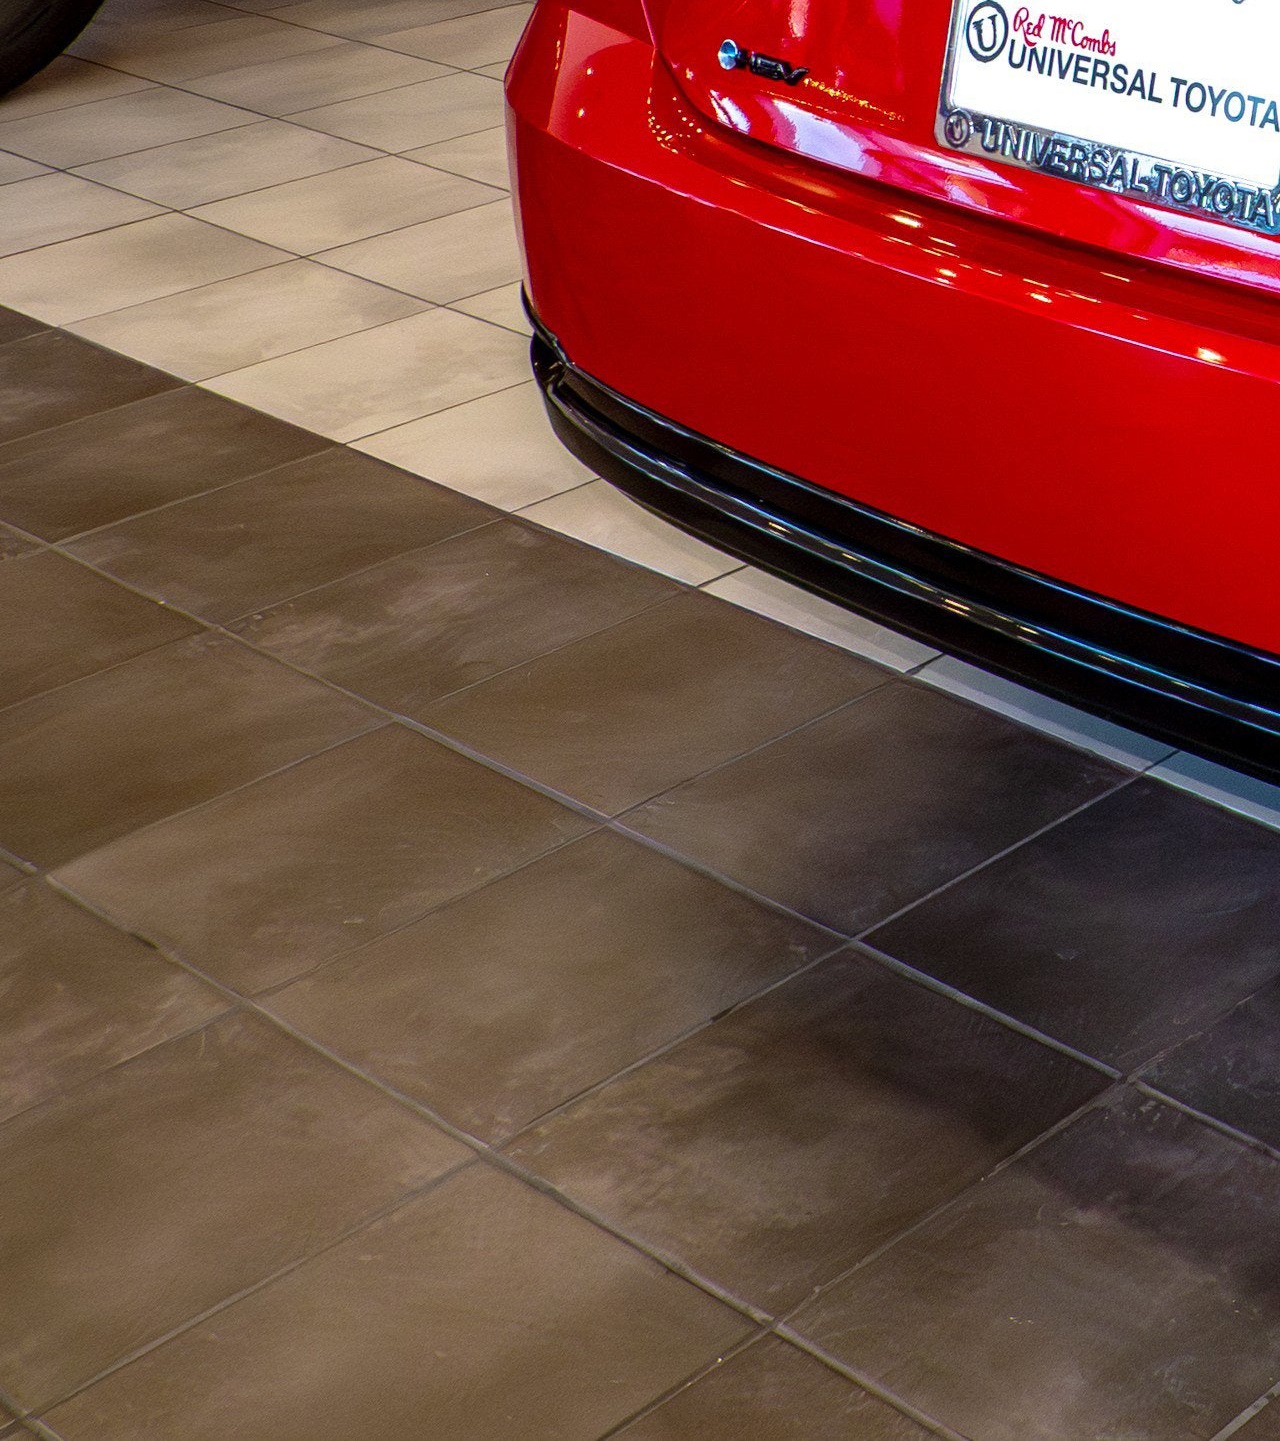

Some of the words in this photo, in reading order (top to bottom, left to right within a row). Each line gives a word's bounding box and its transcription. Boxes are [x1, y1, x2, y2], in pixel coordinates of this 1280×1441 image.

[1013, 7, 1045, 47] Red
[1050, 16, 1117, 56] McCombs
[1007, 39, 1163, 104] UNIVERSAL
[1170, 77, 1280, 132] TOYOTA
[981, 117, 1150, 194] UNIVERSAL
[1155, 165, 1276, 227] TOYOTA
